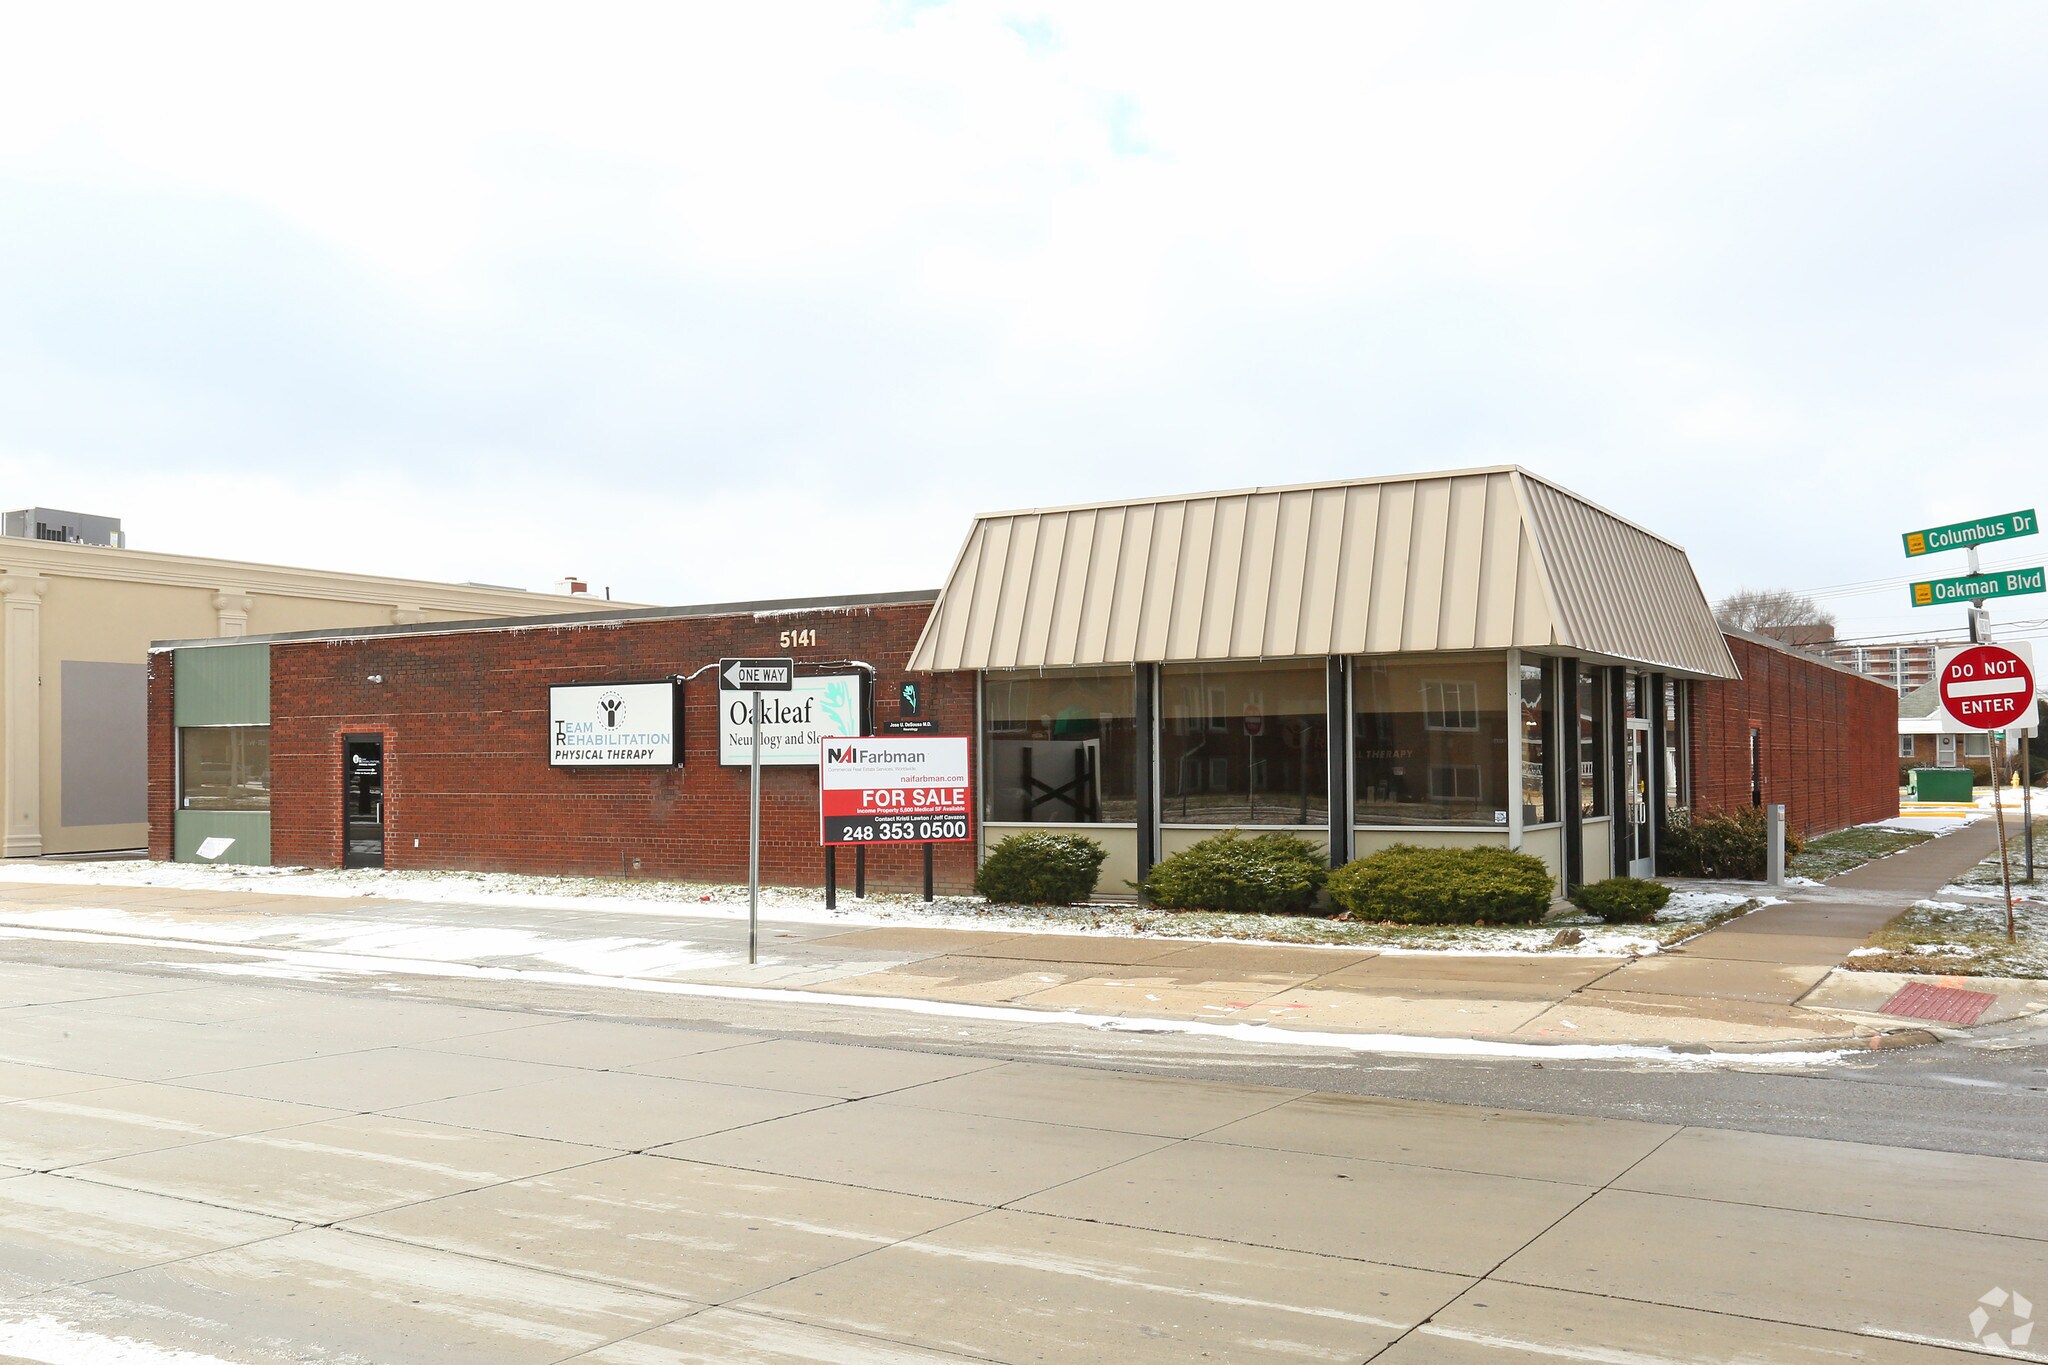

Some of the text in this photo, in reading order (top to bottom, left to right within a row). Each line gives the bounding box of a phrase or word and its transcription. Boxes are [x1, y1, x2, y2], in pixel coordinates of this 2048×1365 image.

[1928, 521, 2005, 548] Columbus
[2012, 515, 2032, 533] Dr
[1935, 579, 1999, 600] Oakman
[2006, 571, 2042, 591] Blvd
[780, 629, 816, 649] 5141
[738, 669, 785, 681] ONE WAY
[1951, 659, 2017, 679] DO NOT
[1961, 698, 2015, 715] ENTER
[555, 720, 593, 735] TEAM
[556, 732, 670, 746] REHABILITATION
[729, 730, 834, 750] Neurlogy and Sle
[555, 749, 654, 760] PHYSICAL THERAPY
[828, 745, 925, 763] NAI Farbman
[1366, 750, 1414, 759] THERAPY
[900, 775, 964, 783] naifarbman.com
[862, 788, 965, 807] FOR SALE
[843, 821, 966, 841] 248 353 0500
